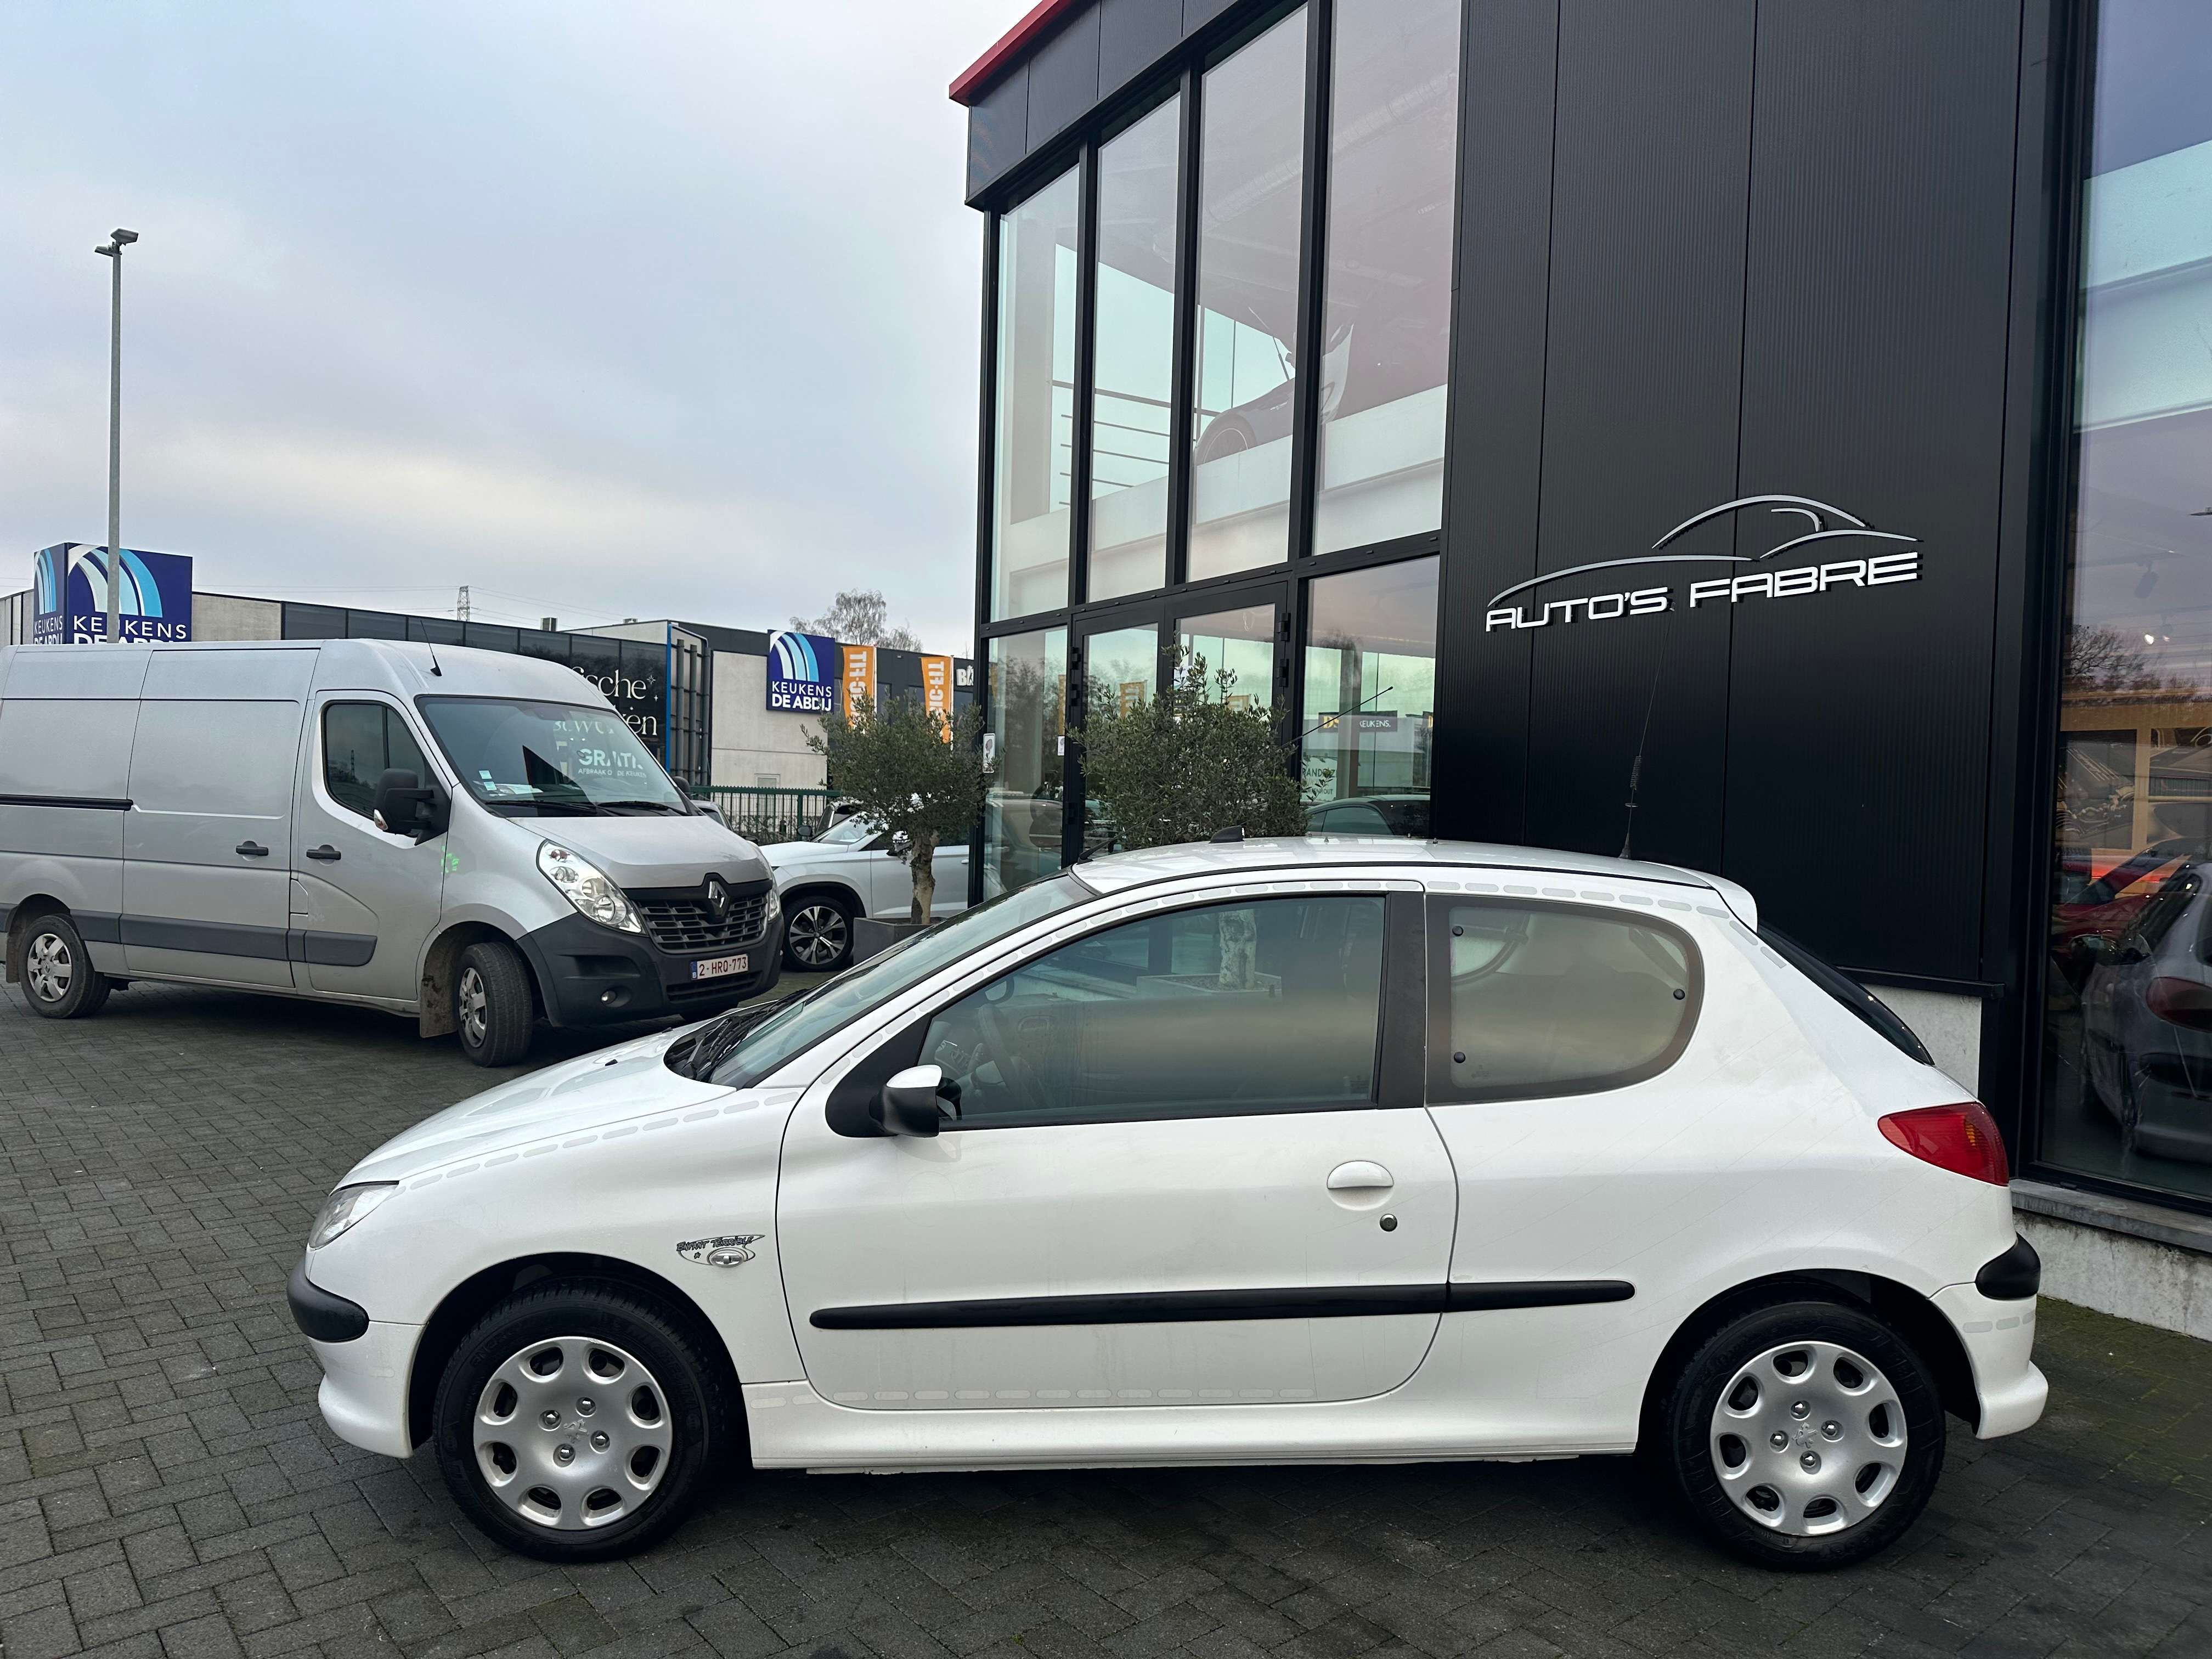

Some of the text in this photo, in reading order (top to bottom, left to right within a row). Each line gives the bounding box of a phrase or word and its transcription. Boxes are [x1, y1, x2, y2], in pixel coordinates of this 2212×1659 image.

[1486, 551, 1918, 632] AUTO'S FABRE
[34, 615, 63, 635] KEUKENS
[73, 615, 187, 639] KEKENS
[772, 681, 832, 697] KEUKENS
[772, 693, 832, 712] DE ABDIJ
[579, 748, 644, 770] GRATI
[676, 1240, 710, 1252] ENFANT
